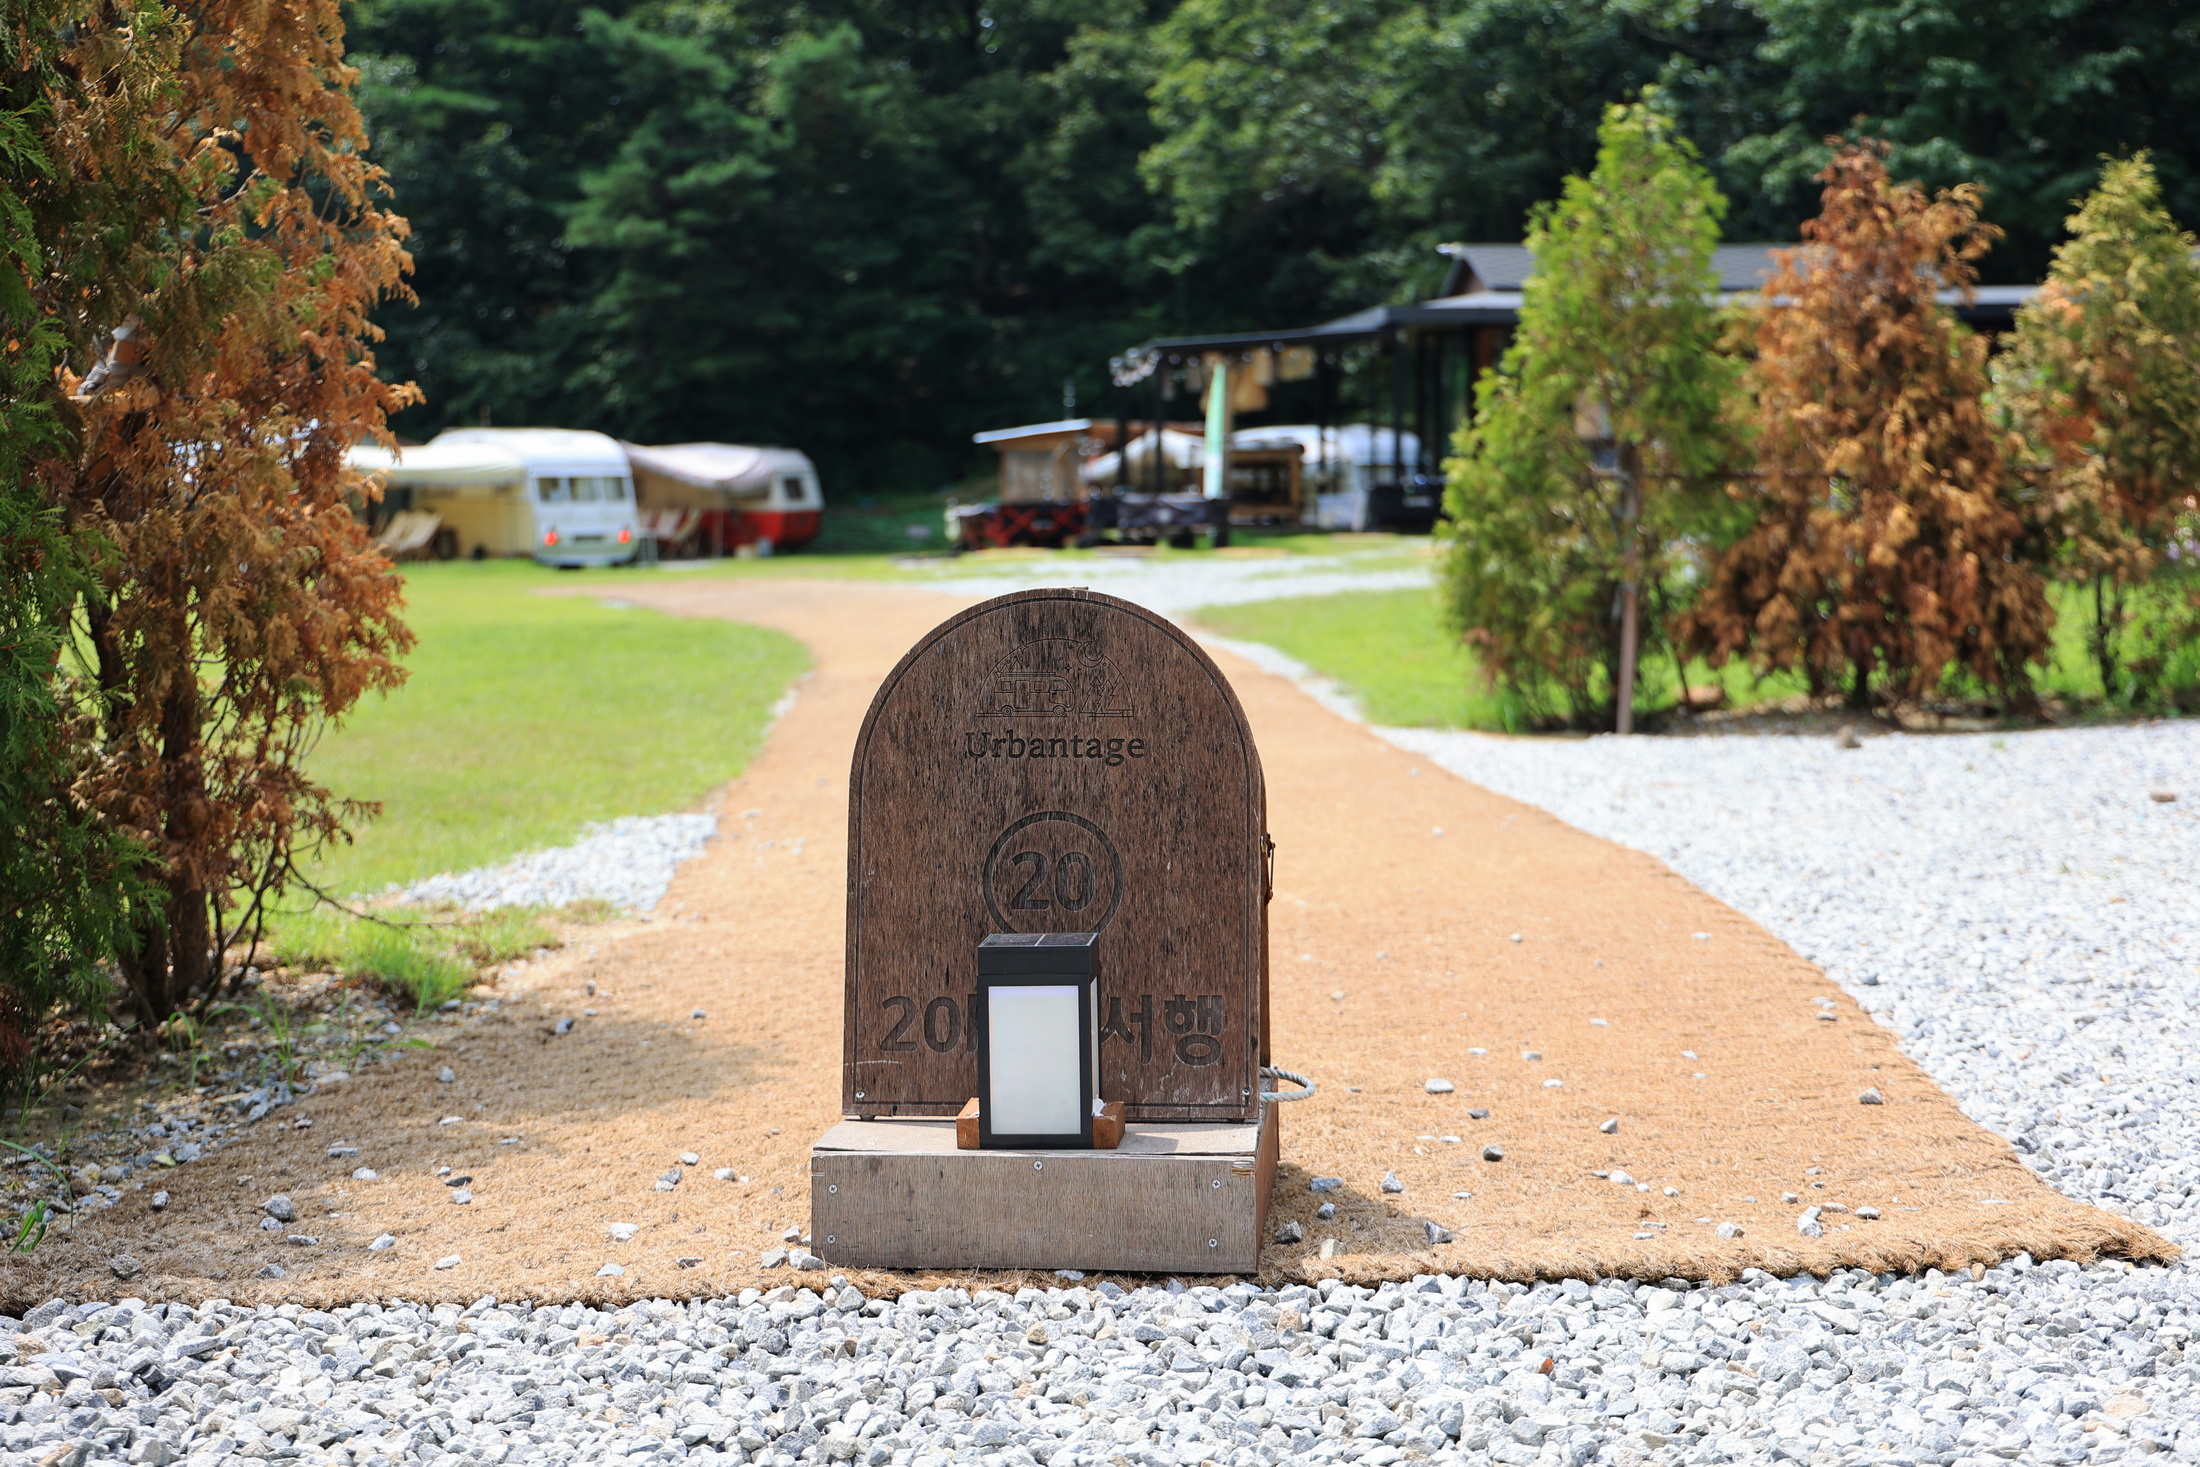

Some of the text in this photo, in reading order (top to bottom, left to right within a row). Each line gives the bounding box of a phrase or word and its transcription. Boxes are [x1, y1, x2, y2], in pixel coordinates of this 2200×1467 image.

[965, 730, 1145, 767] Urbantage
[1011, 851, 1095, 911] 20
[880, 994, 1222, 1067] 20 서행
